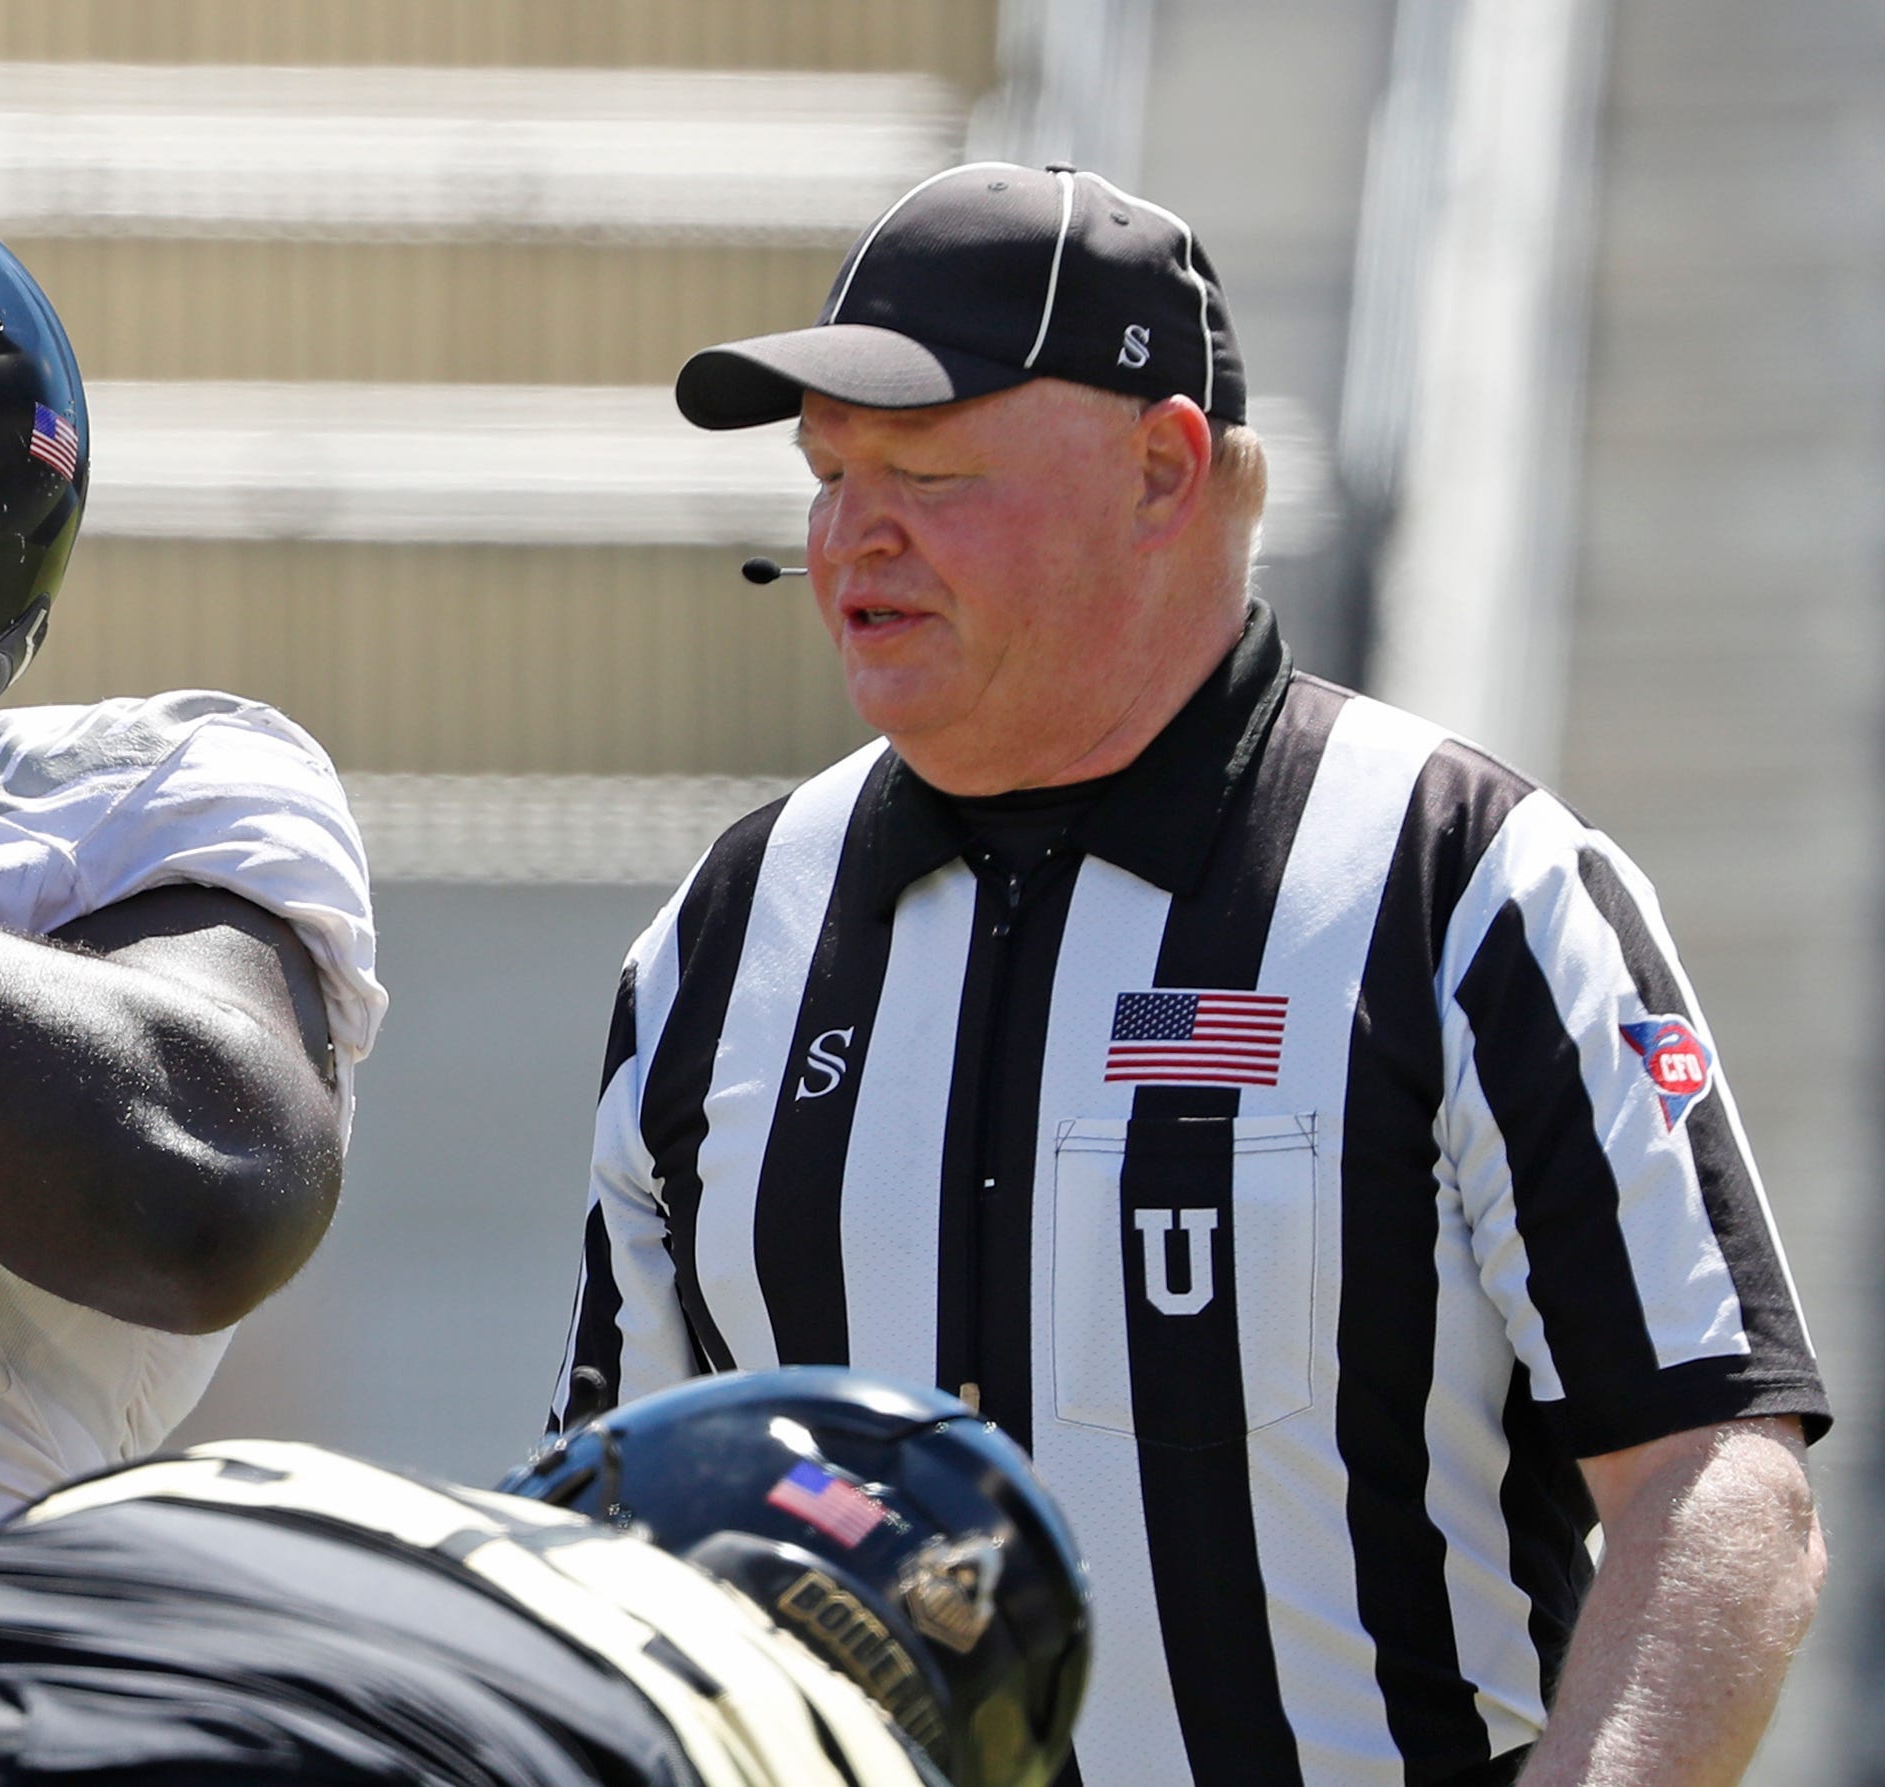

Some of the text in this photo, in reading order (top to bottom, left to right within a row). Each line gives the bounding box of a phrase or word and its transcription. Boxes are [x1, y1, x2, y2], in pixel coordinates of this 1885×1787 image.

[1116, 324, 1151, 369] S
[794, 1026, 855, 1101] S
[1659, 1053, 1703, 1082] CFO
[1133, 1207, 1218, 1315] U
